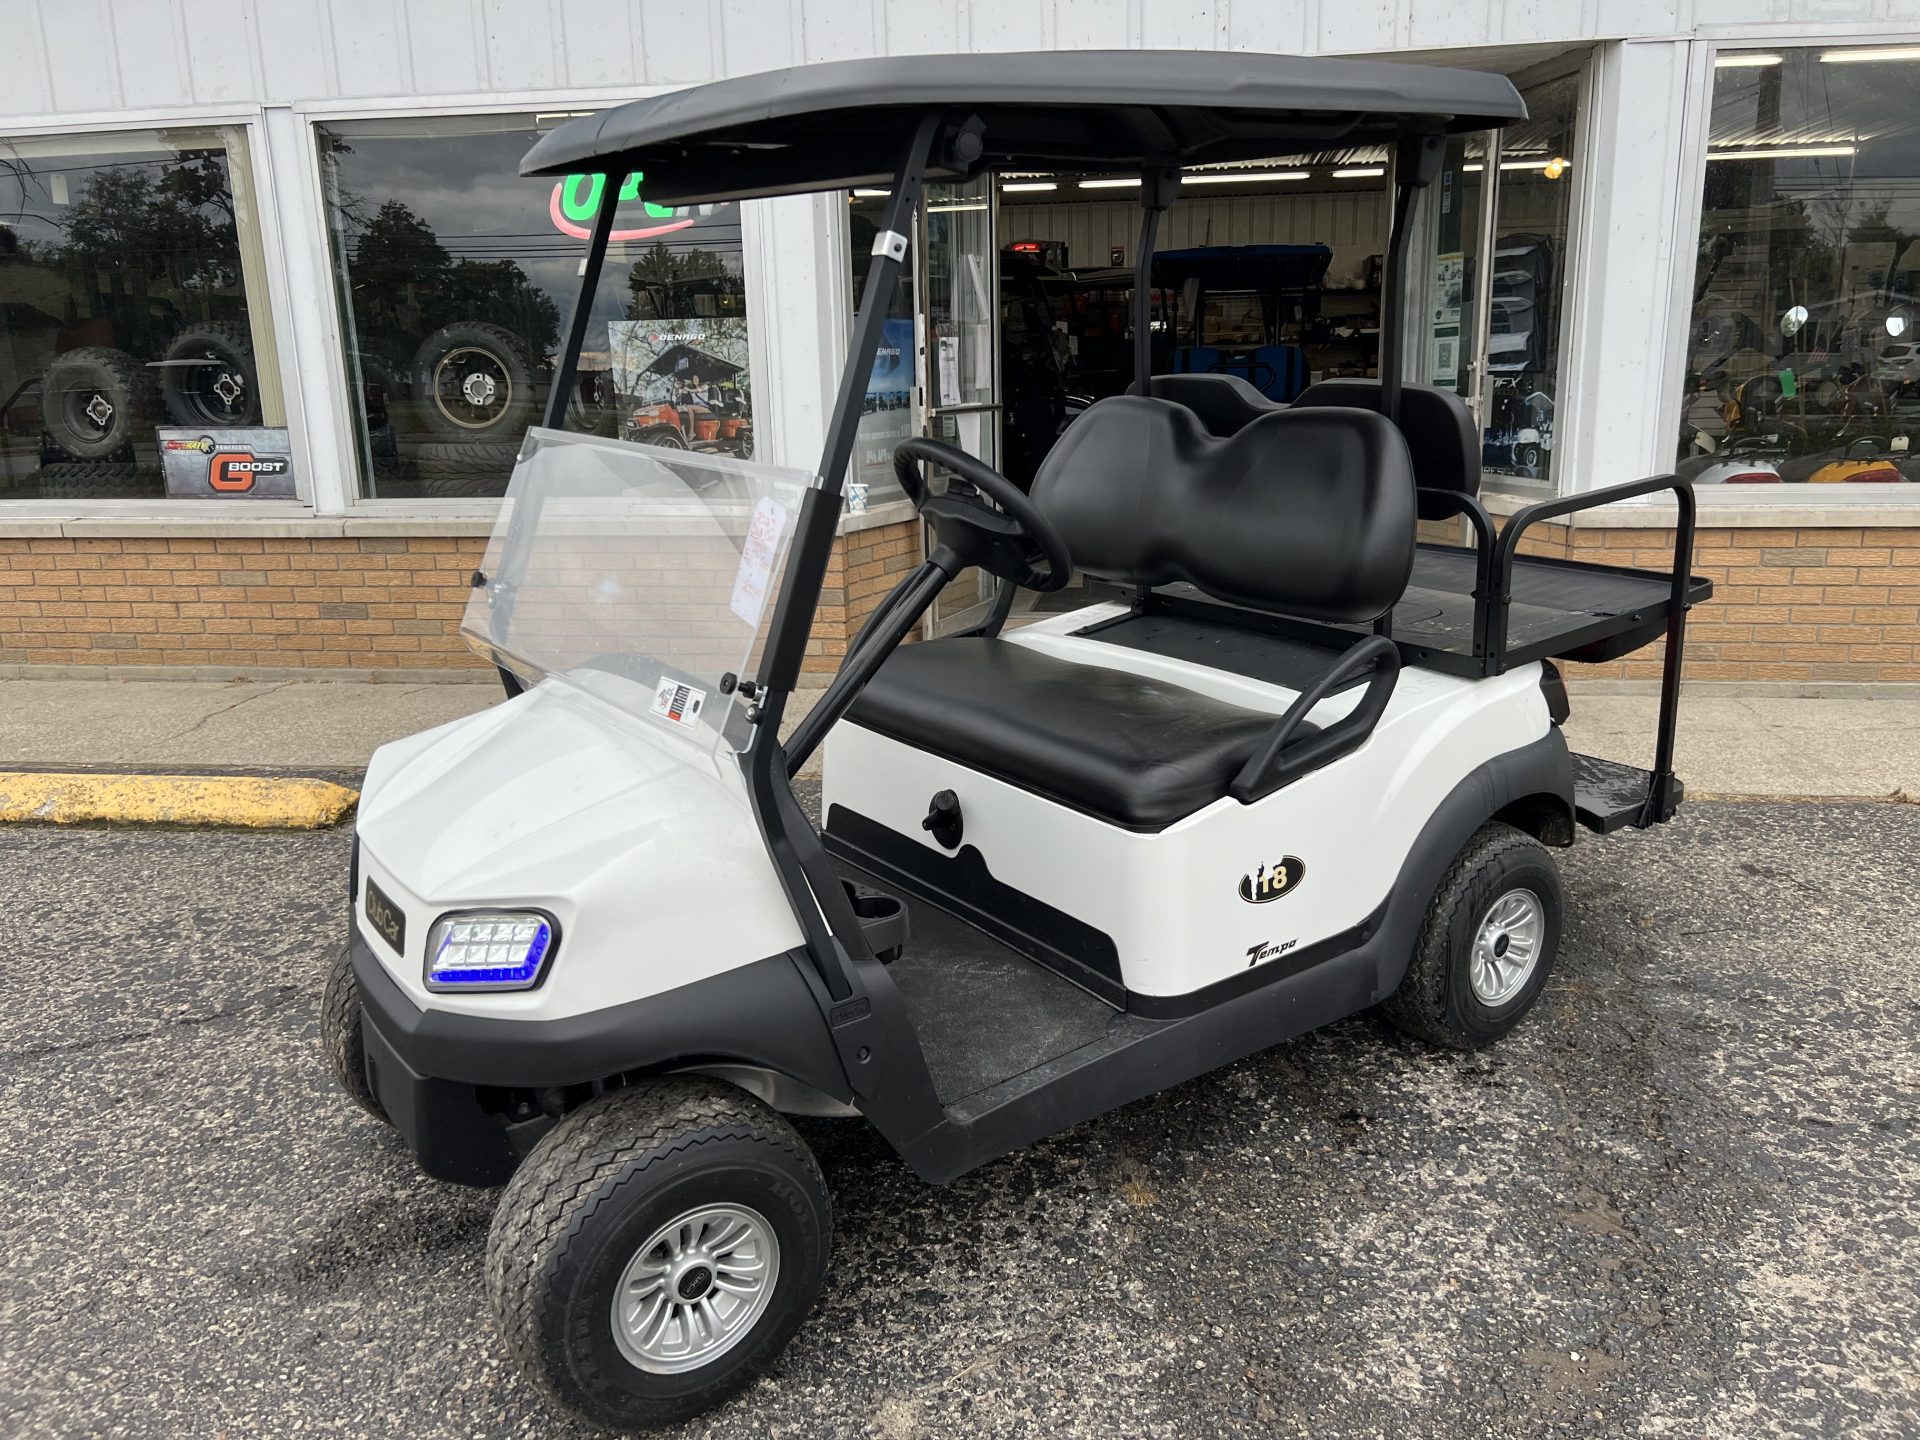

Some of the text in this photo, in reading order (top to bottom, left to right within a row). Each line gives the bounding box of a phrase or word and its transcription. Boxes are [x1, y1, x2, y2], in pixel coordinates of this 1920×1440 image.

[659, 333, 706, 341] DENAGO
[877, 347, 901, 356] ENAGO
[228, 462, 284, 472] BOOST
[1246, 938, 1299, 967] Tempo
